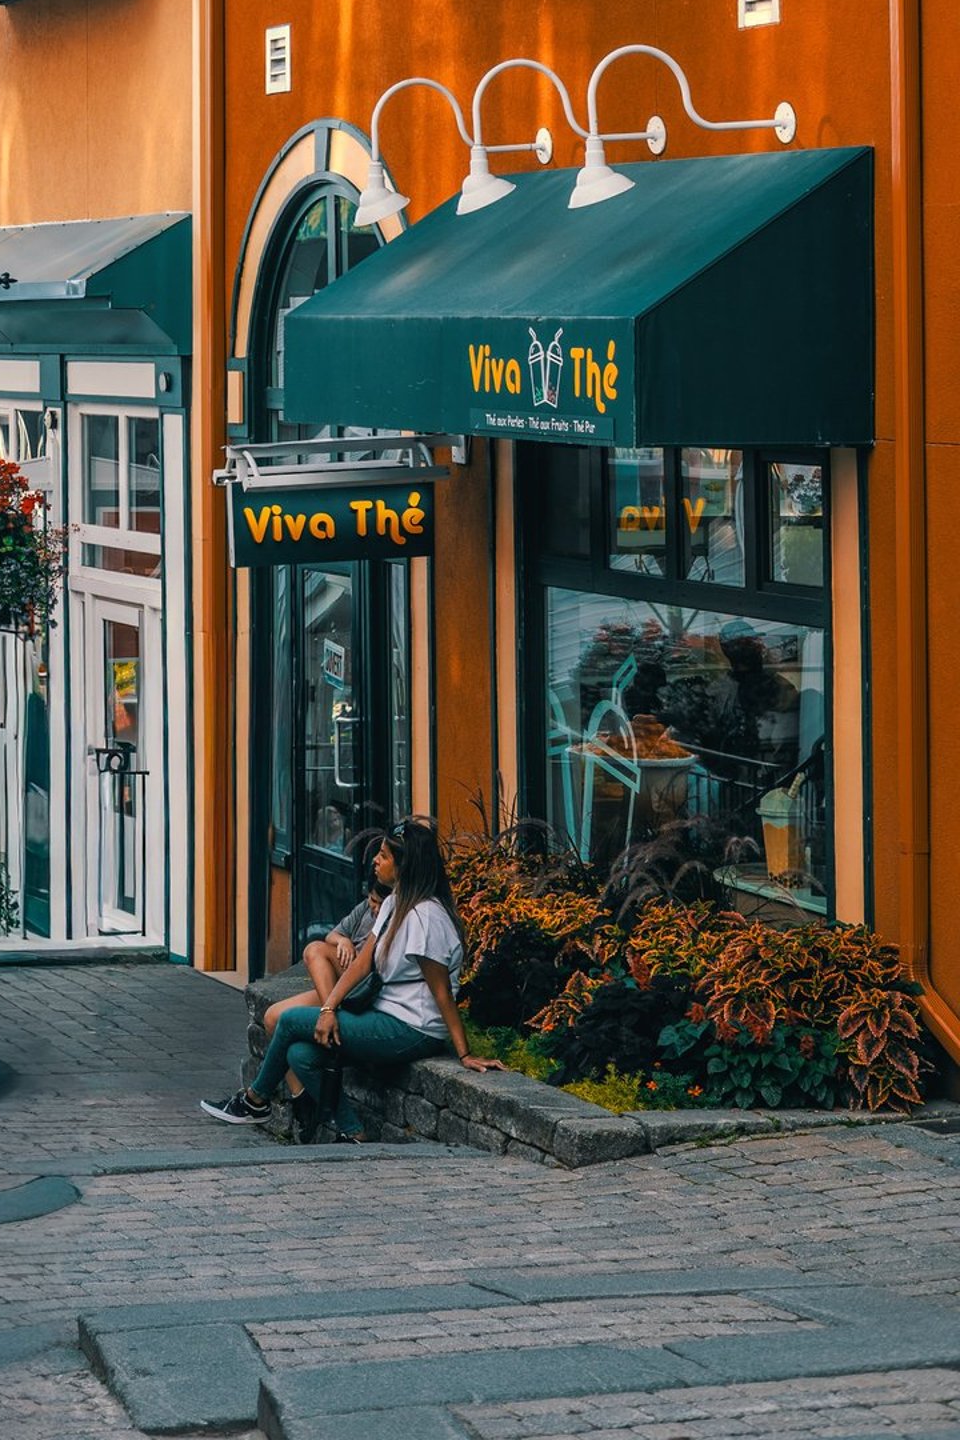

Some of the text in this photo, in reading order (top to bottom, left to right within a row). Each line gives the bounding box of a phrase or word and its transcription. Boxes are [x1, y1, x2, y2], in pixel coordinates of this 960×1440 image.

[468, 339, 619, 414] Viva Thé
[485, 413, 496, 426] Thé
[497, 418, 507, 426] aux
[528, 416, 539, 429] Thé
[243, 491, 426, 546] Viva Thé
